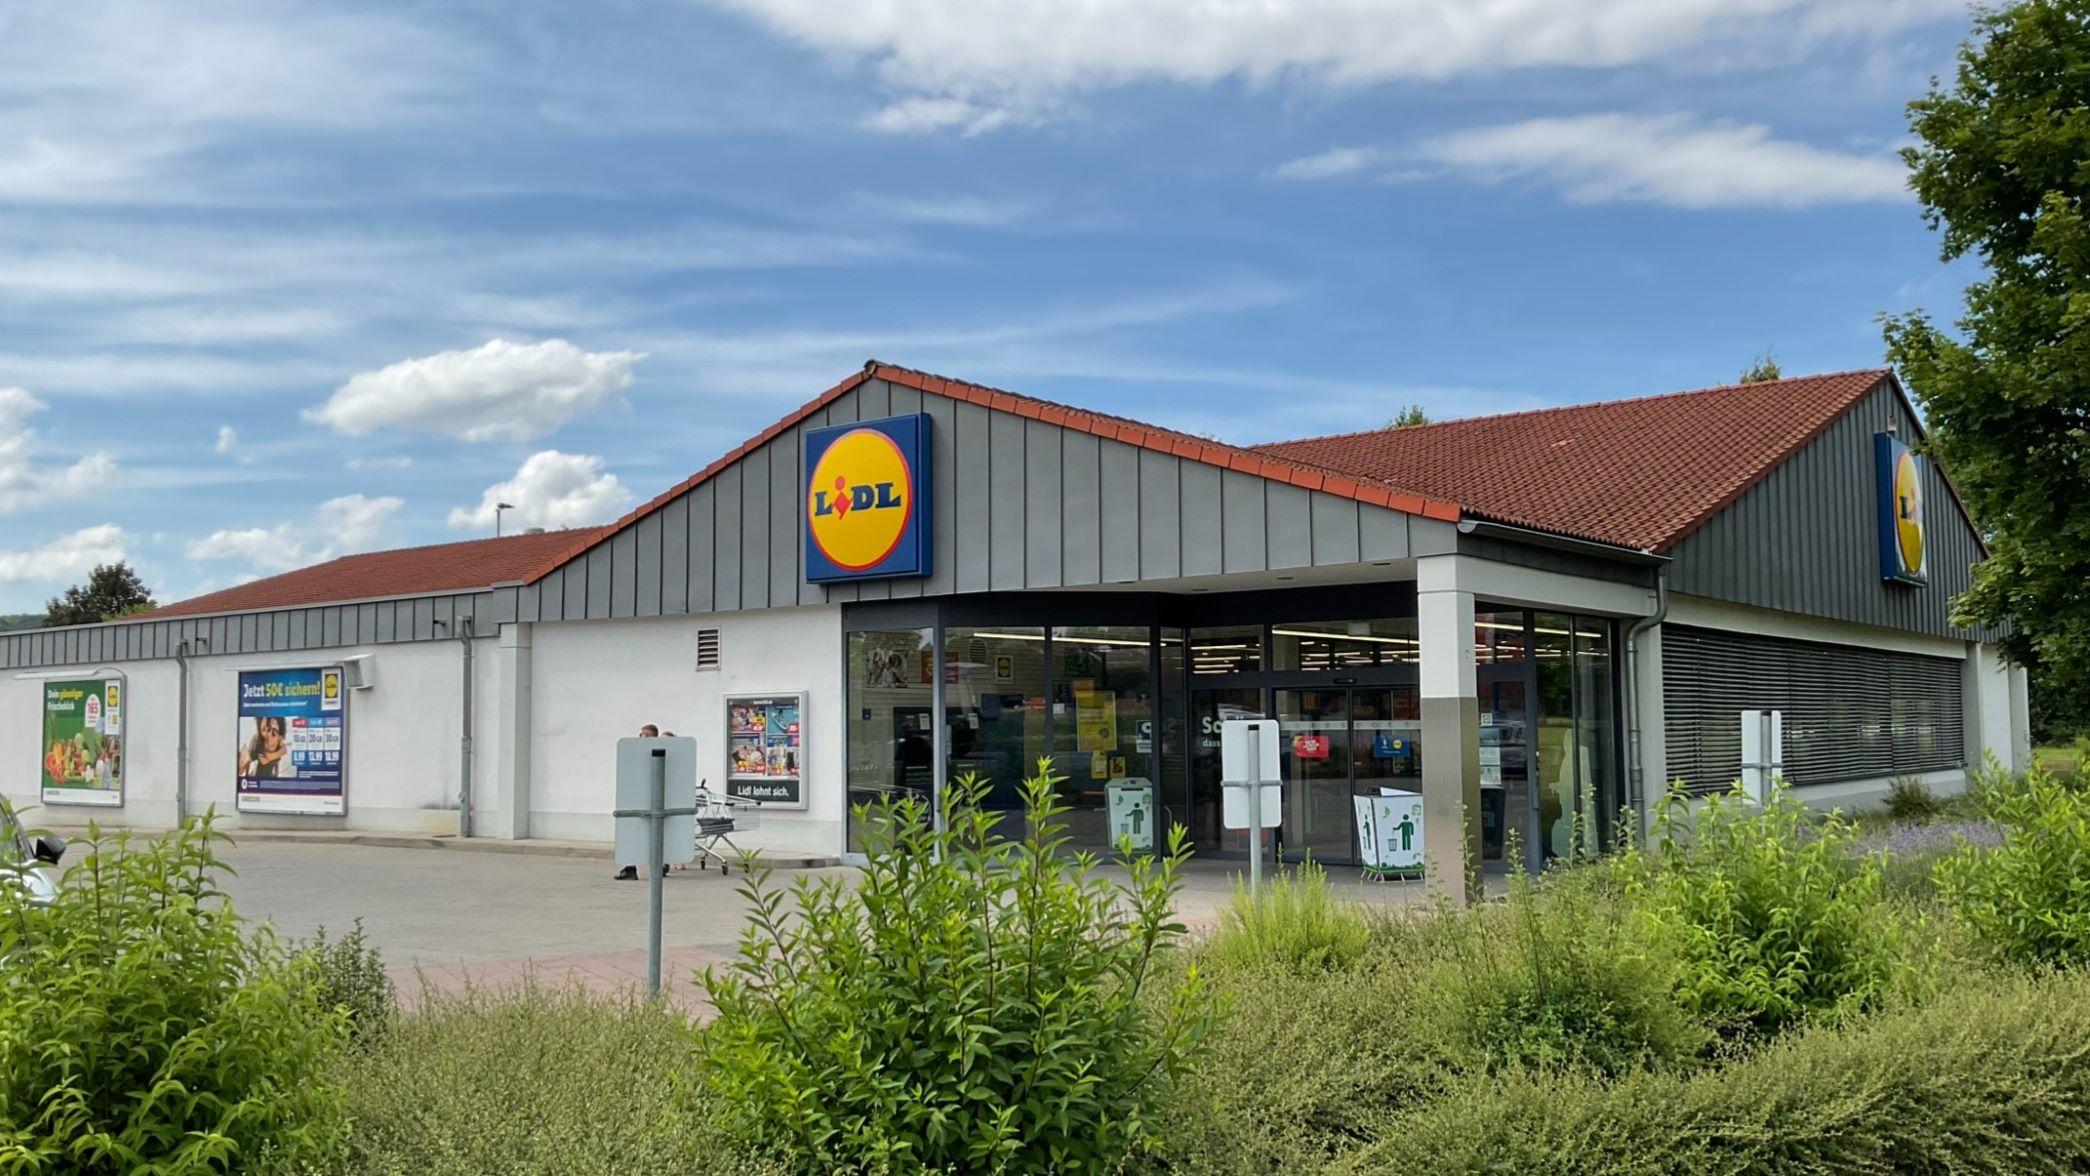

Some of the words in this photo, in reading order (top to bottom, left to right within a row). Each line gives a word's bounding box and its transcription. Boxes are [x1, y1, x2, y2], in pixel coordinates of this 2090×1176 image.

[244, 684, 264, 697] Jetzt
[266, 682, 283, 697] 50€
[285, 682, 320, 696] sichern!
[738, 785, 752, 796] Lidl
[753, 786, 772, 796] lohnt
[773, 786, 789, 797] sich.
